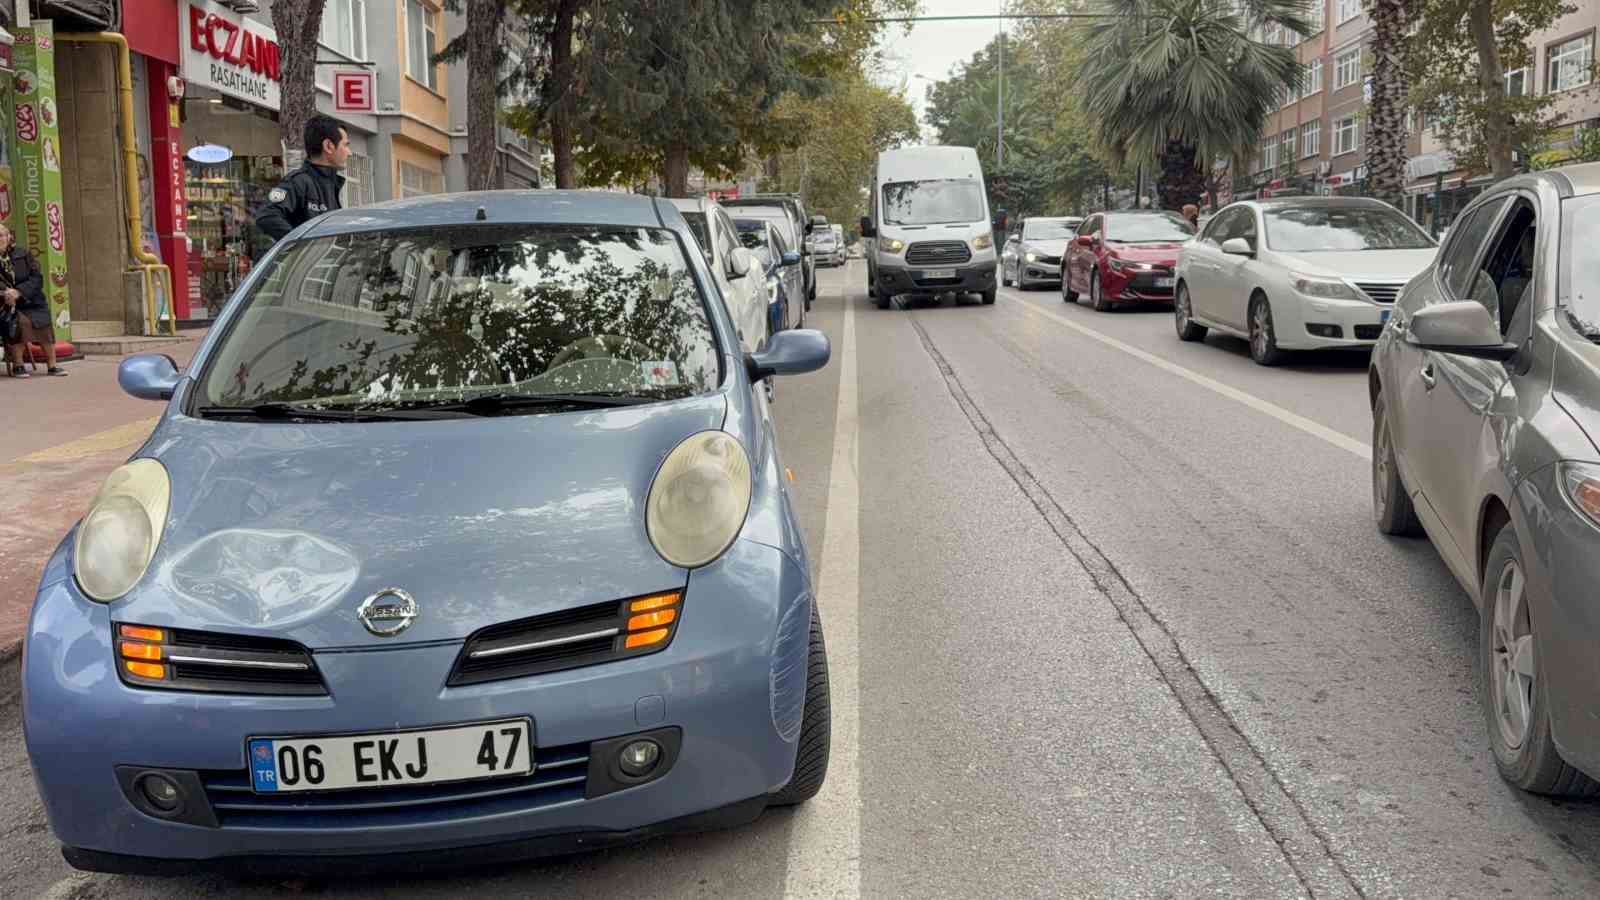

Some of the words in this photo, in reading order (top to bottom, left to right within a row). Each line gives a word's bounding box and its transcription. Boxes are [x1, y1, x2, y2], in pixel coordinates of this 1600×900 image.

[210, 63, 267, 99] RASATHANE
[343, 79, 364, 105] E
[171, 142, 183, 231] ECZANE
[363, 606, 411, 617] NISSAN
[278, 745, 325, 786] 06
[353, 738, 428, 782] EKJ
[476, 727, 522, 771] 47
[256, 770, 275, 782] TR
